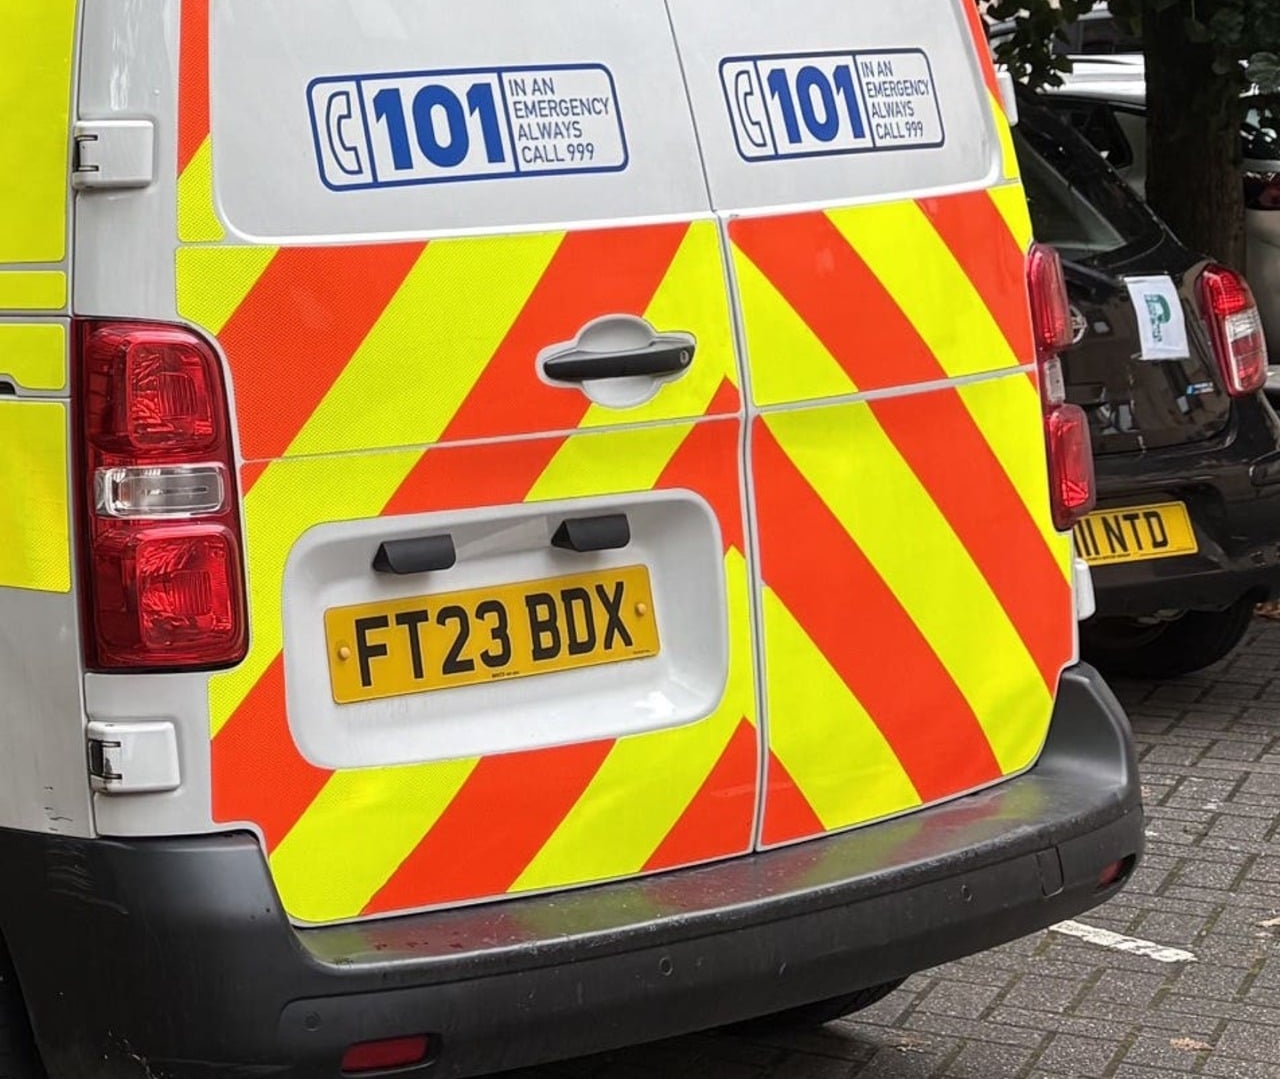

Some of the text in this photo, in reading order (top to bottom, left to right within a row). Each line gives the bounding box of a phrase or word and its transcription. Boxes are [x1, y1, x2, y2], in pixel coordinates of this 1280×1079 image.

[860, 60, 894, 78] IN AN
[508, 77, 555, 97] IN AN
[865, 79, 930, 98] EMERGENCY
[514, 97, 610, 119] EMERGENCY
[767, 65, 866, 144] 101
[871, 101, 915, 119] ALWAYS
[373, 82, 506, 171] 101
[517, 121, 583, 141] ALWAYS
[875, 121, 924, 140] CALL 999
[521, 142, 595, 164] CALL 999
[1101, 510, 1169, 554] NTD
[353, 581, 633, 688] FT23 BDX
